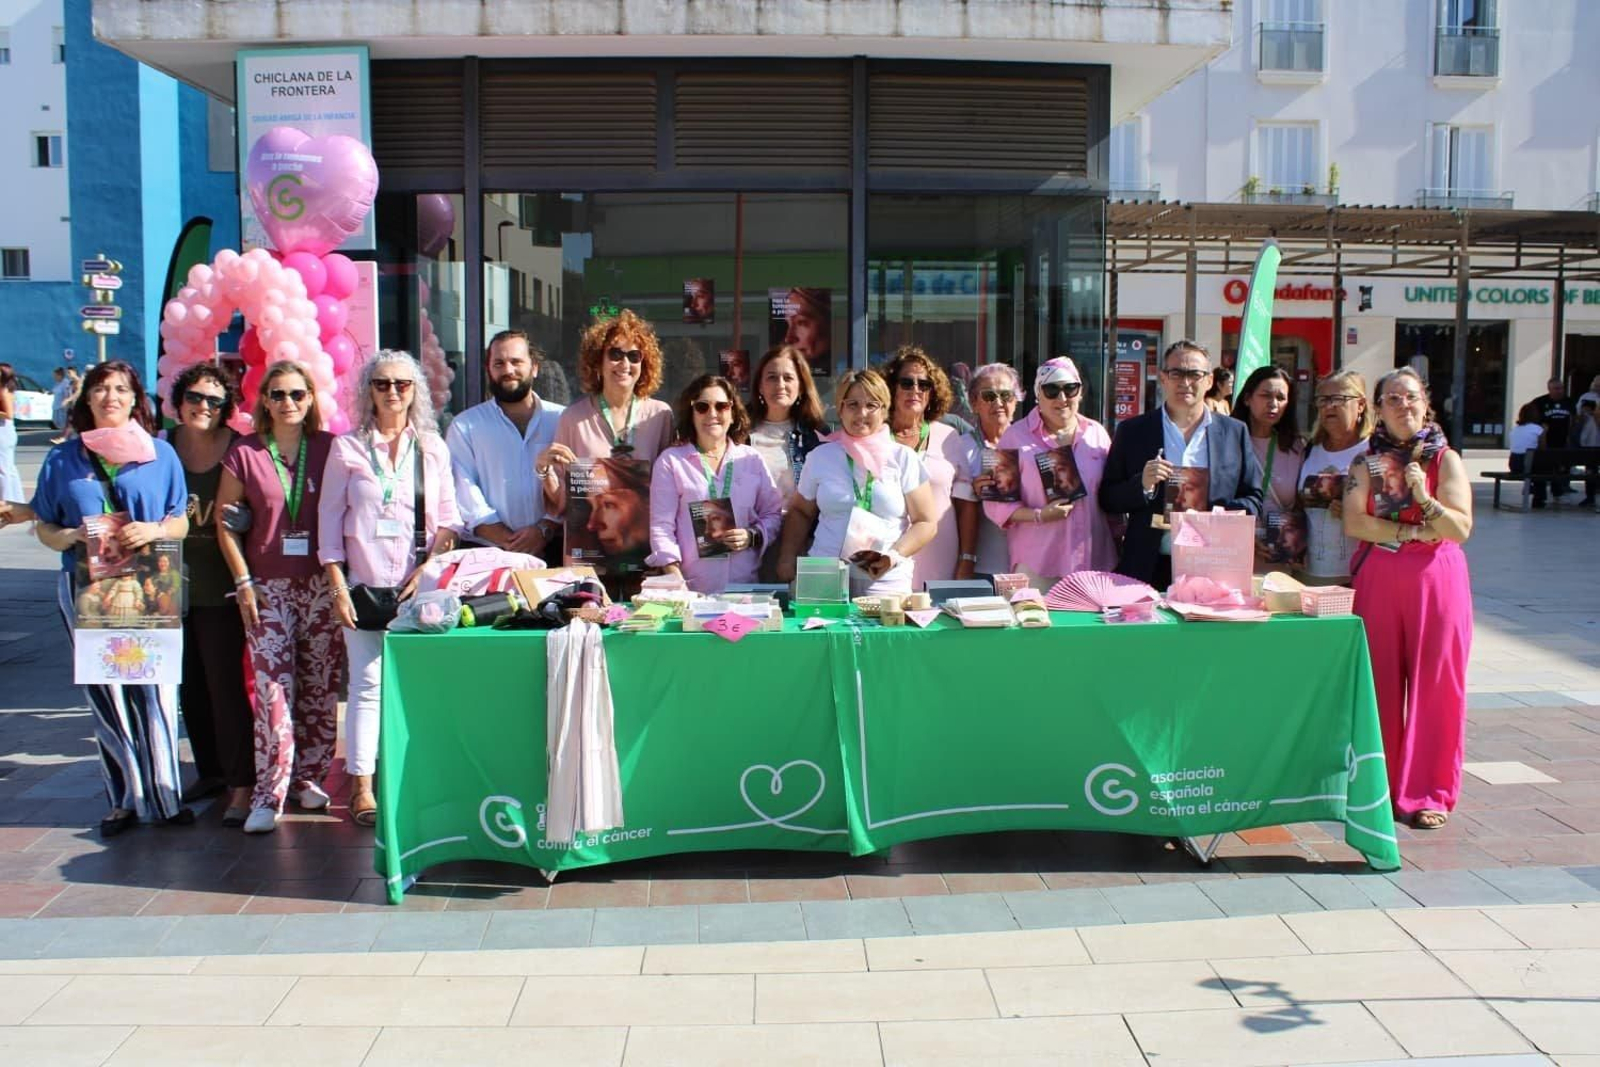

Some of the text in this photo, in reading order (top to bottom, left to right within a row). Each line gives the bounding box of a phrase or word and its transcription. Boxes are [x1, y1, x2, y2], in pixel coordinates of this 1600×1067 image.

[254, 71, 352, 84] CHICLANA DE LA
[271, 85, 336, 97] FRONTERA
[1273, 282, 1348, 301] odafon
[1476, 288, 1550, 304] COLORS
[1150, 766, 1225, 784] asociación
[1150, 784, 1214, 803] española
[1150, 799, 1262, 817] contra el cáncer
[586, 834, 599, 847] el
[602, 827, 652, 844] cáncer
